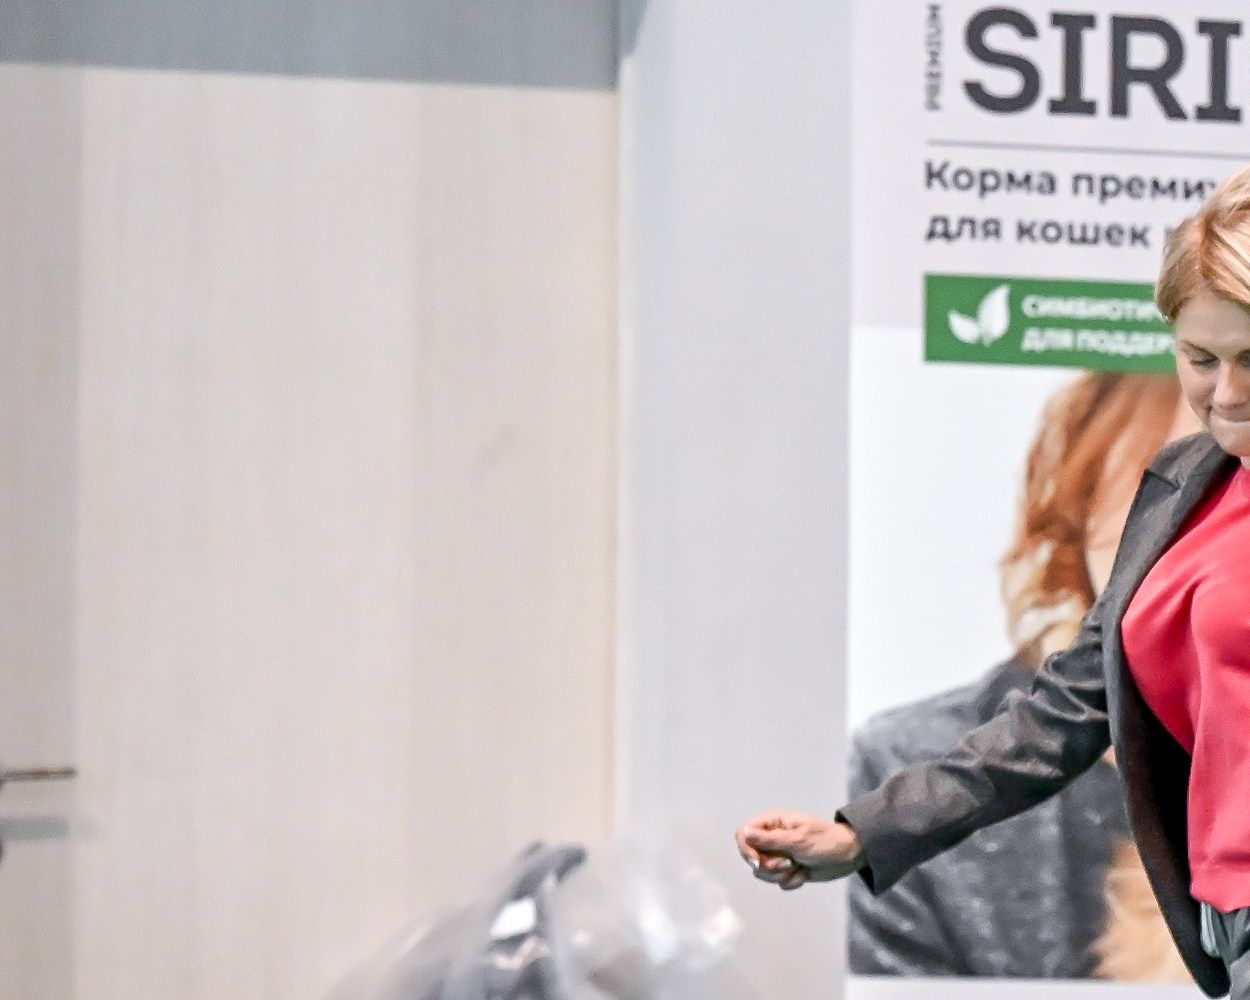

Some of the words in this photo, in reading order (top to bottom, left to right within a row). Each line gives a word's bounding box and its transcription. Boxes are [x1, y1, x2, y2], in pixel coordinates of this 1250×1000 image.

[925, 160, 1057, 199] Корма
[926, 215, 1001, 242] для
[1016, 219, 1151, 247] кошек
